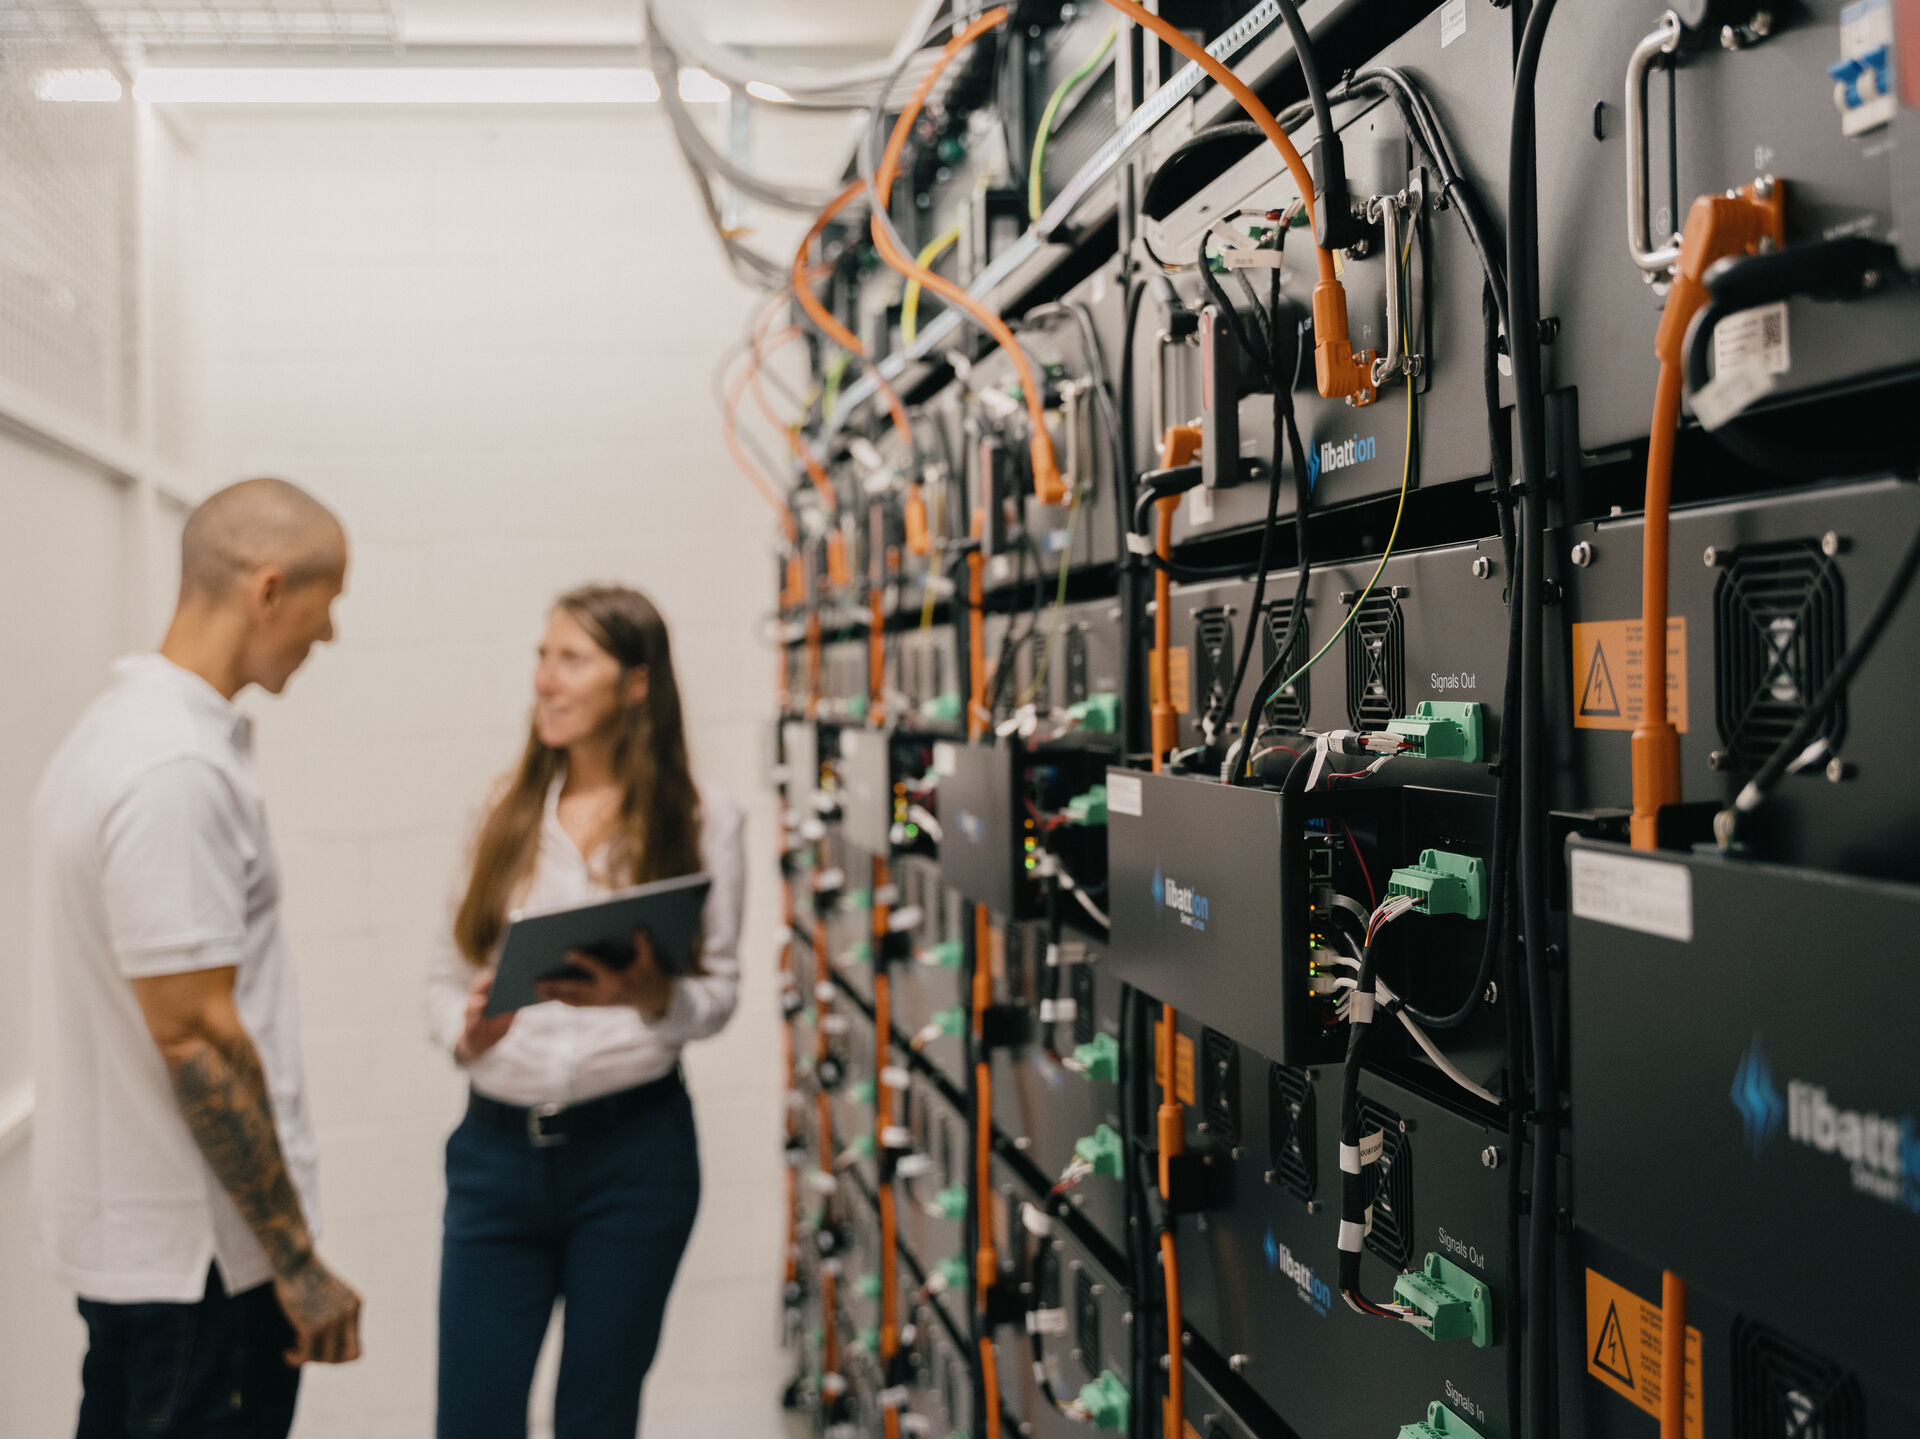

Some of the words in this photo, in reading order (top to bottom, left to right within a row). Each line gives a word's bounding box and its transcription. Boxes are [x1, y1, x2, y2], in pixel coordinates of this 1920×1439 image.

[1320, 433, 1376, 474] libattion
[1431, 672, 1459, 693] Signals
[1461, 672, 1476, 689] Out
[1165, 878, 1209, 920] libattion
[1438, 1226, 1467, 1258] Signals
[1469, 1246, 1485, 1270] Out
[1279, 1242, 1331, 1309] libattion
[1445, 1379, 1474, 1416] Signals
[1476, 1403, 1485, 1424] In
